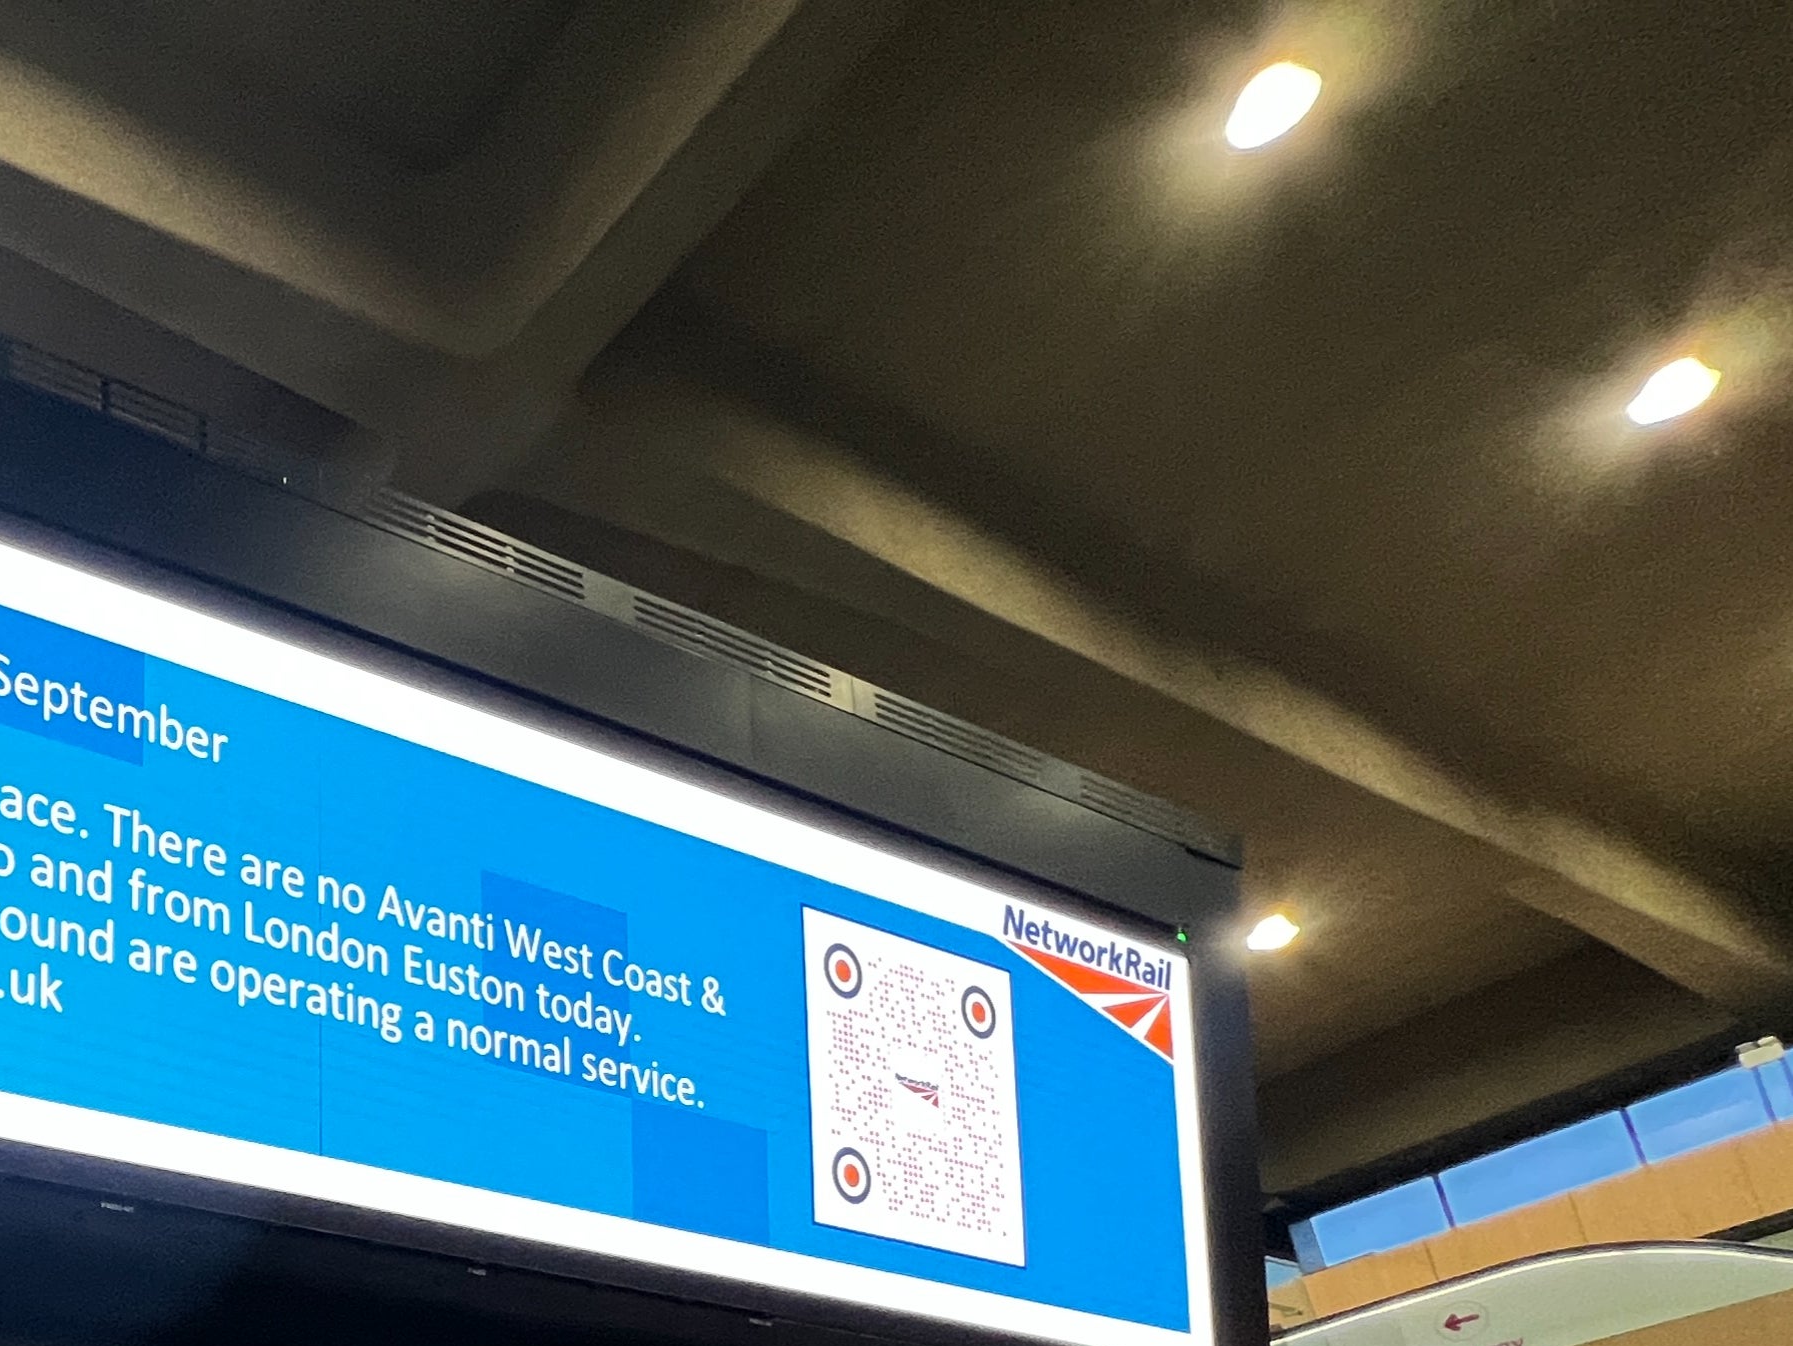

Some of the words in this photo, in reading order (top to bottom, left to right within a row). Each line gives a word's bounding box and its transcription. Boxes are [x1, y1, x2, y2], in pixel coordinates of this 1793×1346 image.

[30, 853, 113, 904] and
[128, 867, 231, 935] from
[244, 901, 389, 976] London
[404, 944, 525, 1012] Euston
[535, 983, 643, 1047] today.
[103, 803, 227, 877] There
[240, 853, 305, 898] are
[317, 875, 366, 914] no
[377, 885, 495, 951] Avanti
[503, 919, 593, 979] West
[602, 949, 692, 1007] Coast
[701, 976, 726, 1016] &
[128, 938, 198, 984] are
[210, 959, 403, 1043] operating
[414, 1011, 434, 1042] a
[447, 1018, 571, 1076] normal
[582, 1053, 706, 1108] service.
